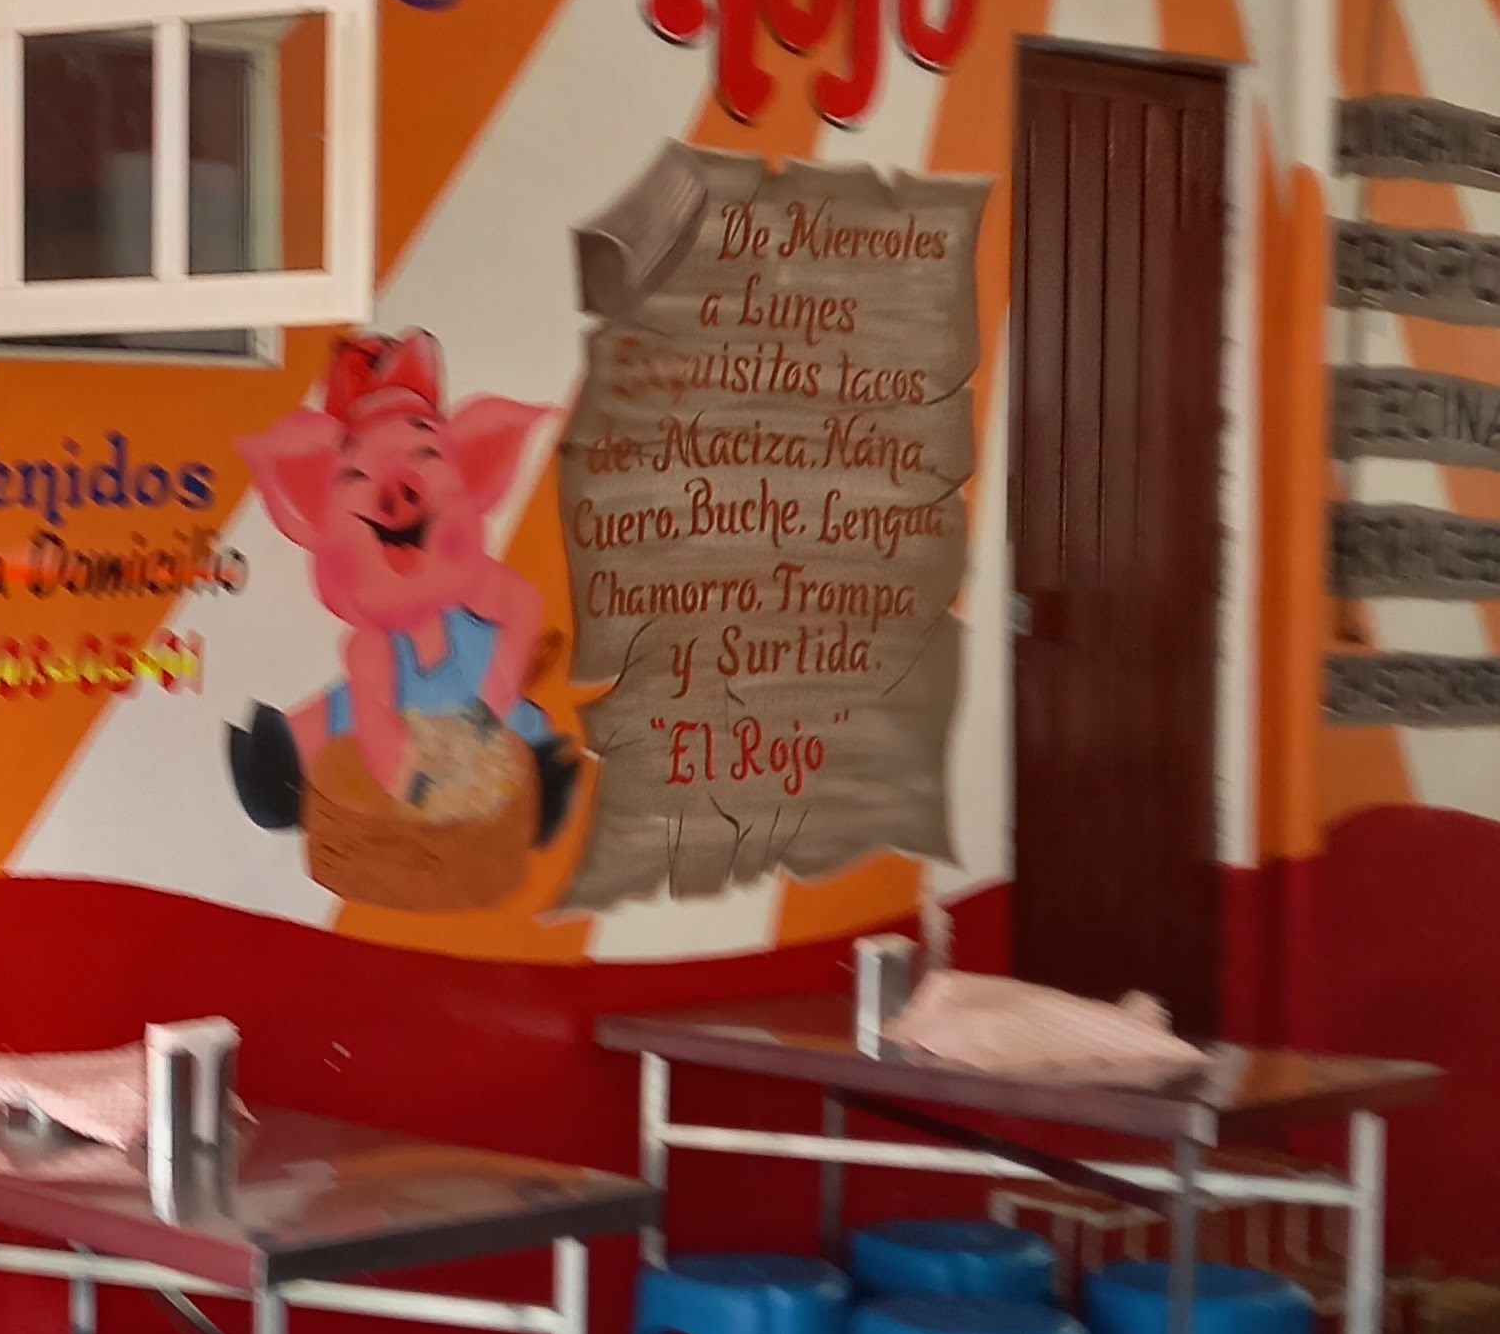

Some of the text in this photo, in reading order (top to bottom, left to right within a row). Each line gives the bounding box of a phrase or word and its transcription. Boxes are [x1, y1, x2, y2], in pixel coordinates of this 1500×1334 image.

[718, 197, 948, 261] De Miercoles
[700, 272, 858, 346] a Lunes
[838, 352, 926, 406] tacos
[816, 490, 946, 558] Lengua
[772, 562, 916, 633] Trompa
[670, 637, 697, 699] y
